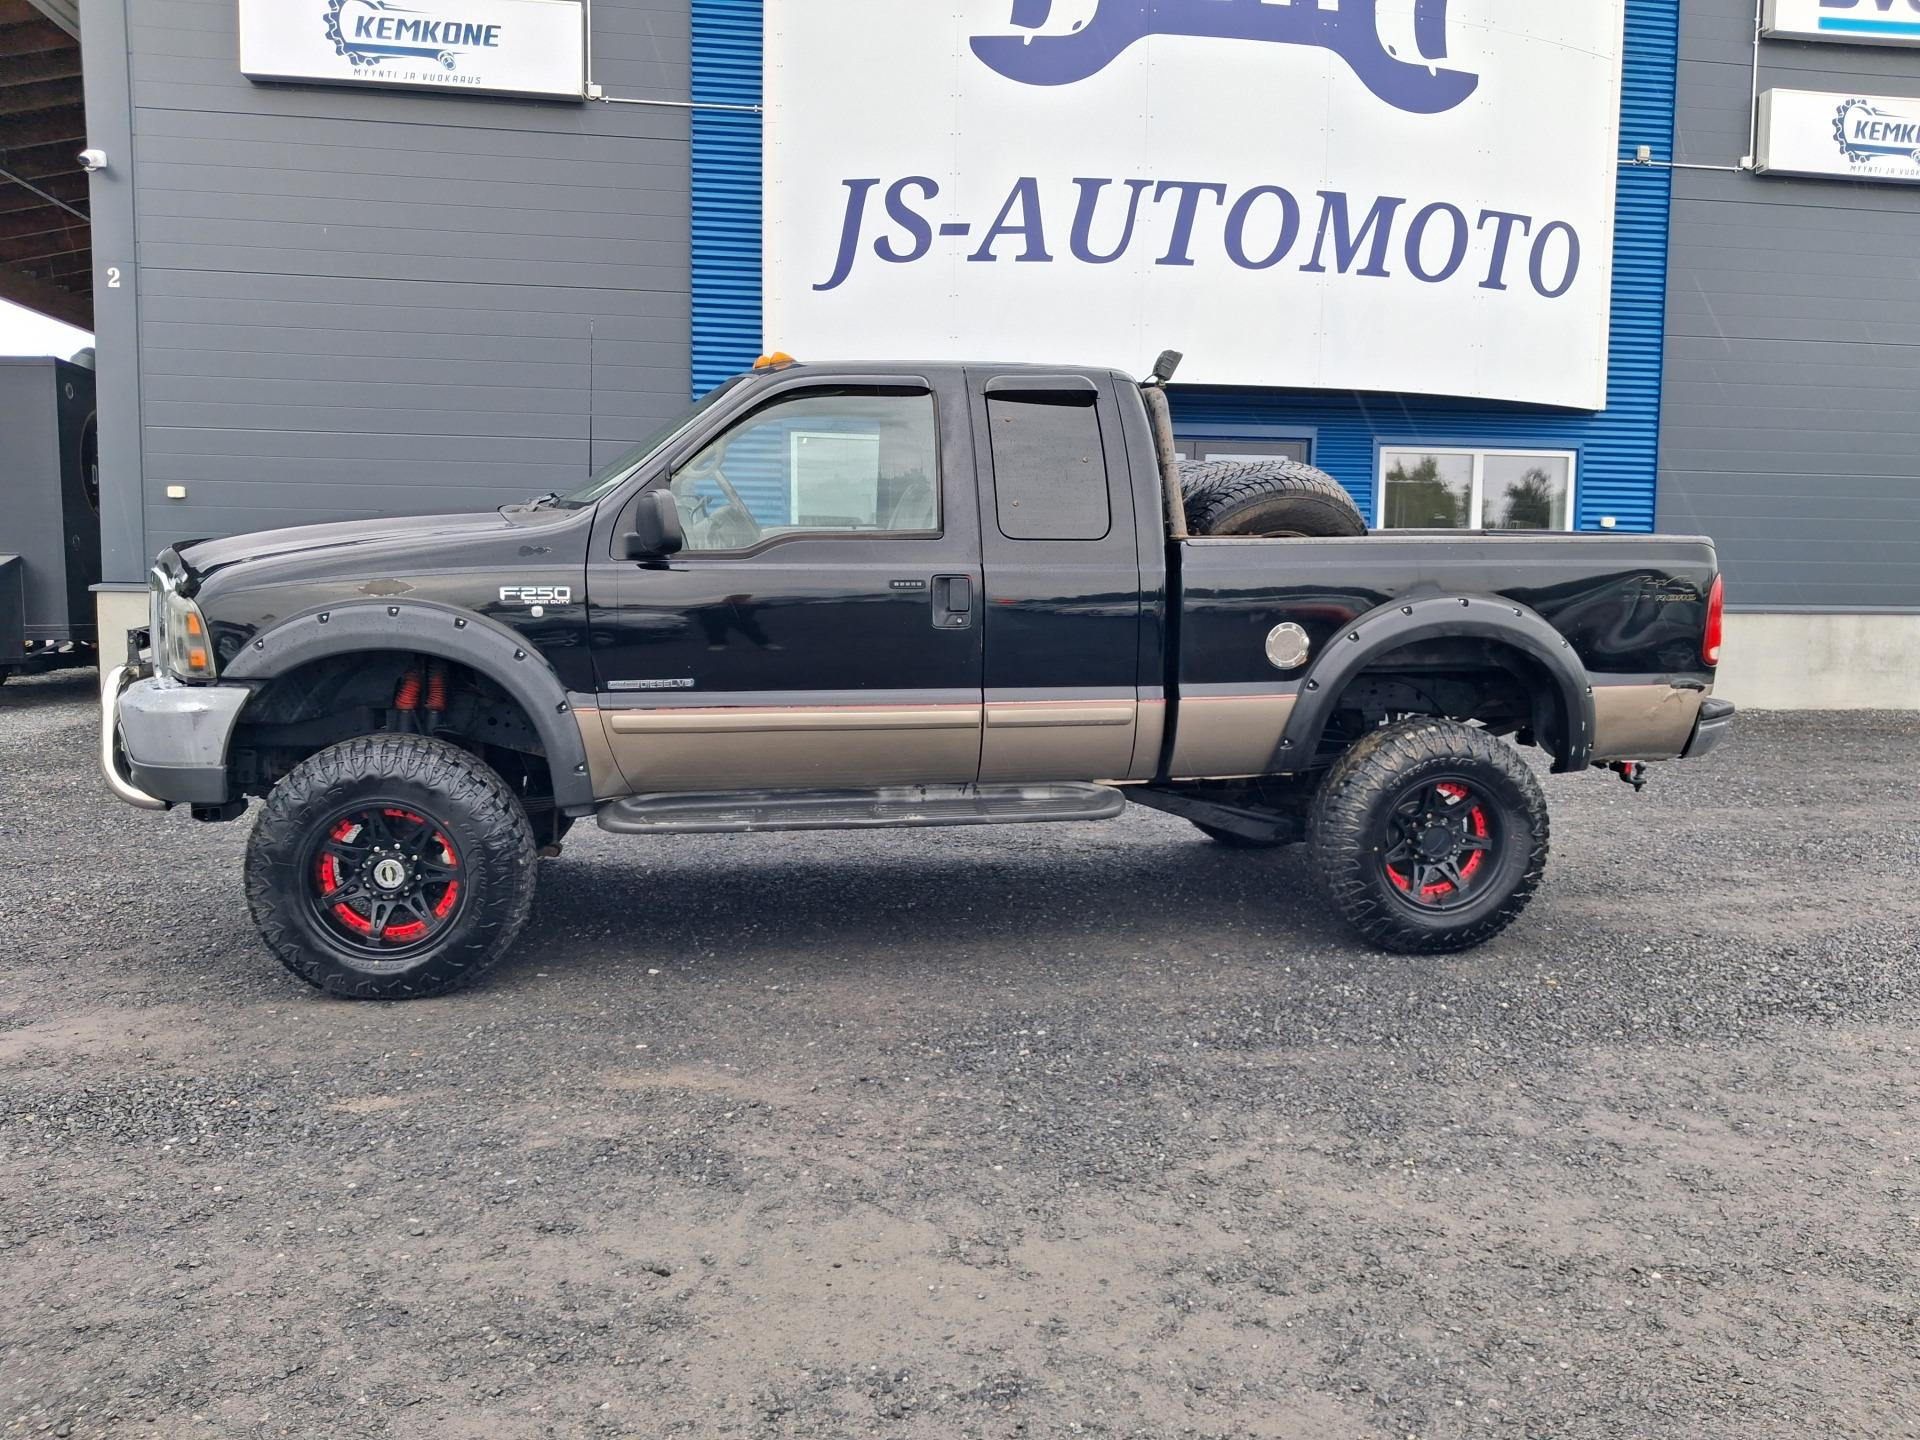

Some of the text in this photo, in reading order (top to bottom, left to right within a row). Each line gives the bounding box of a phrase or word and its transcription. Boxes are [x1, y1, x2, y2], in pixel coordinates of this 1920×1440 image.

[355, 16, 501, 47] KEMKONE
[354, 68, 397, 79] MYYNTI
[423, 73, 482, 84] VUOKRAUS
[1854, 120, 1920, 143] KEMK
[813, 176, 1580, 298] JS-AUTOMOTO
[107, 267, 121, 288] 2
[499, 586, 571, 601] F-250
